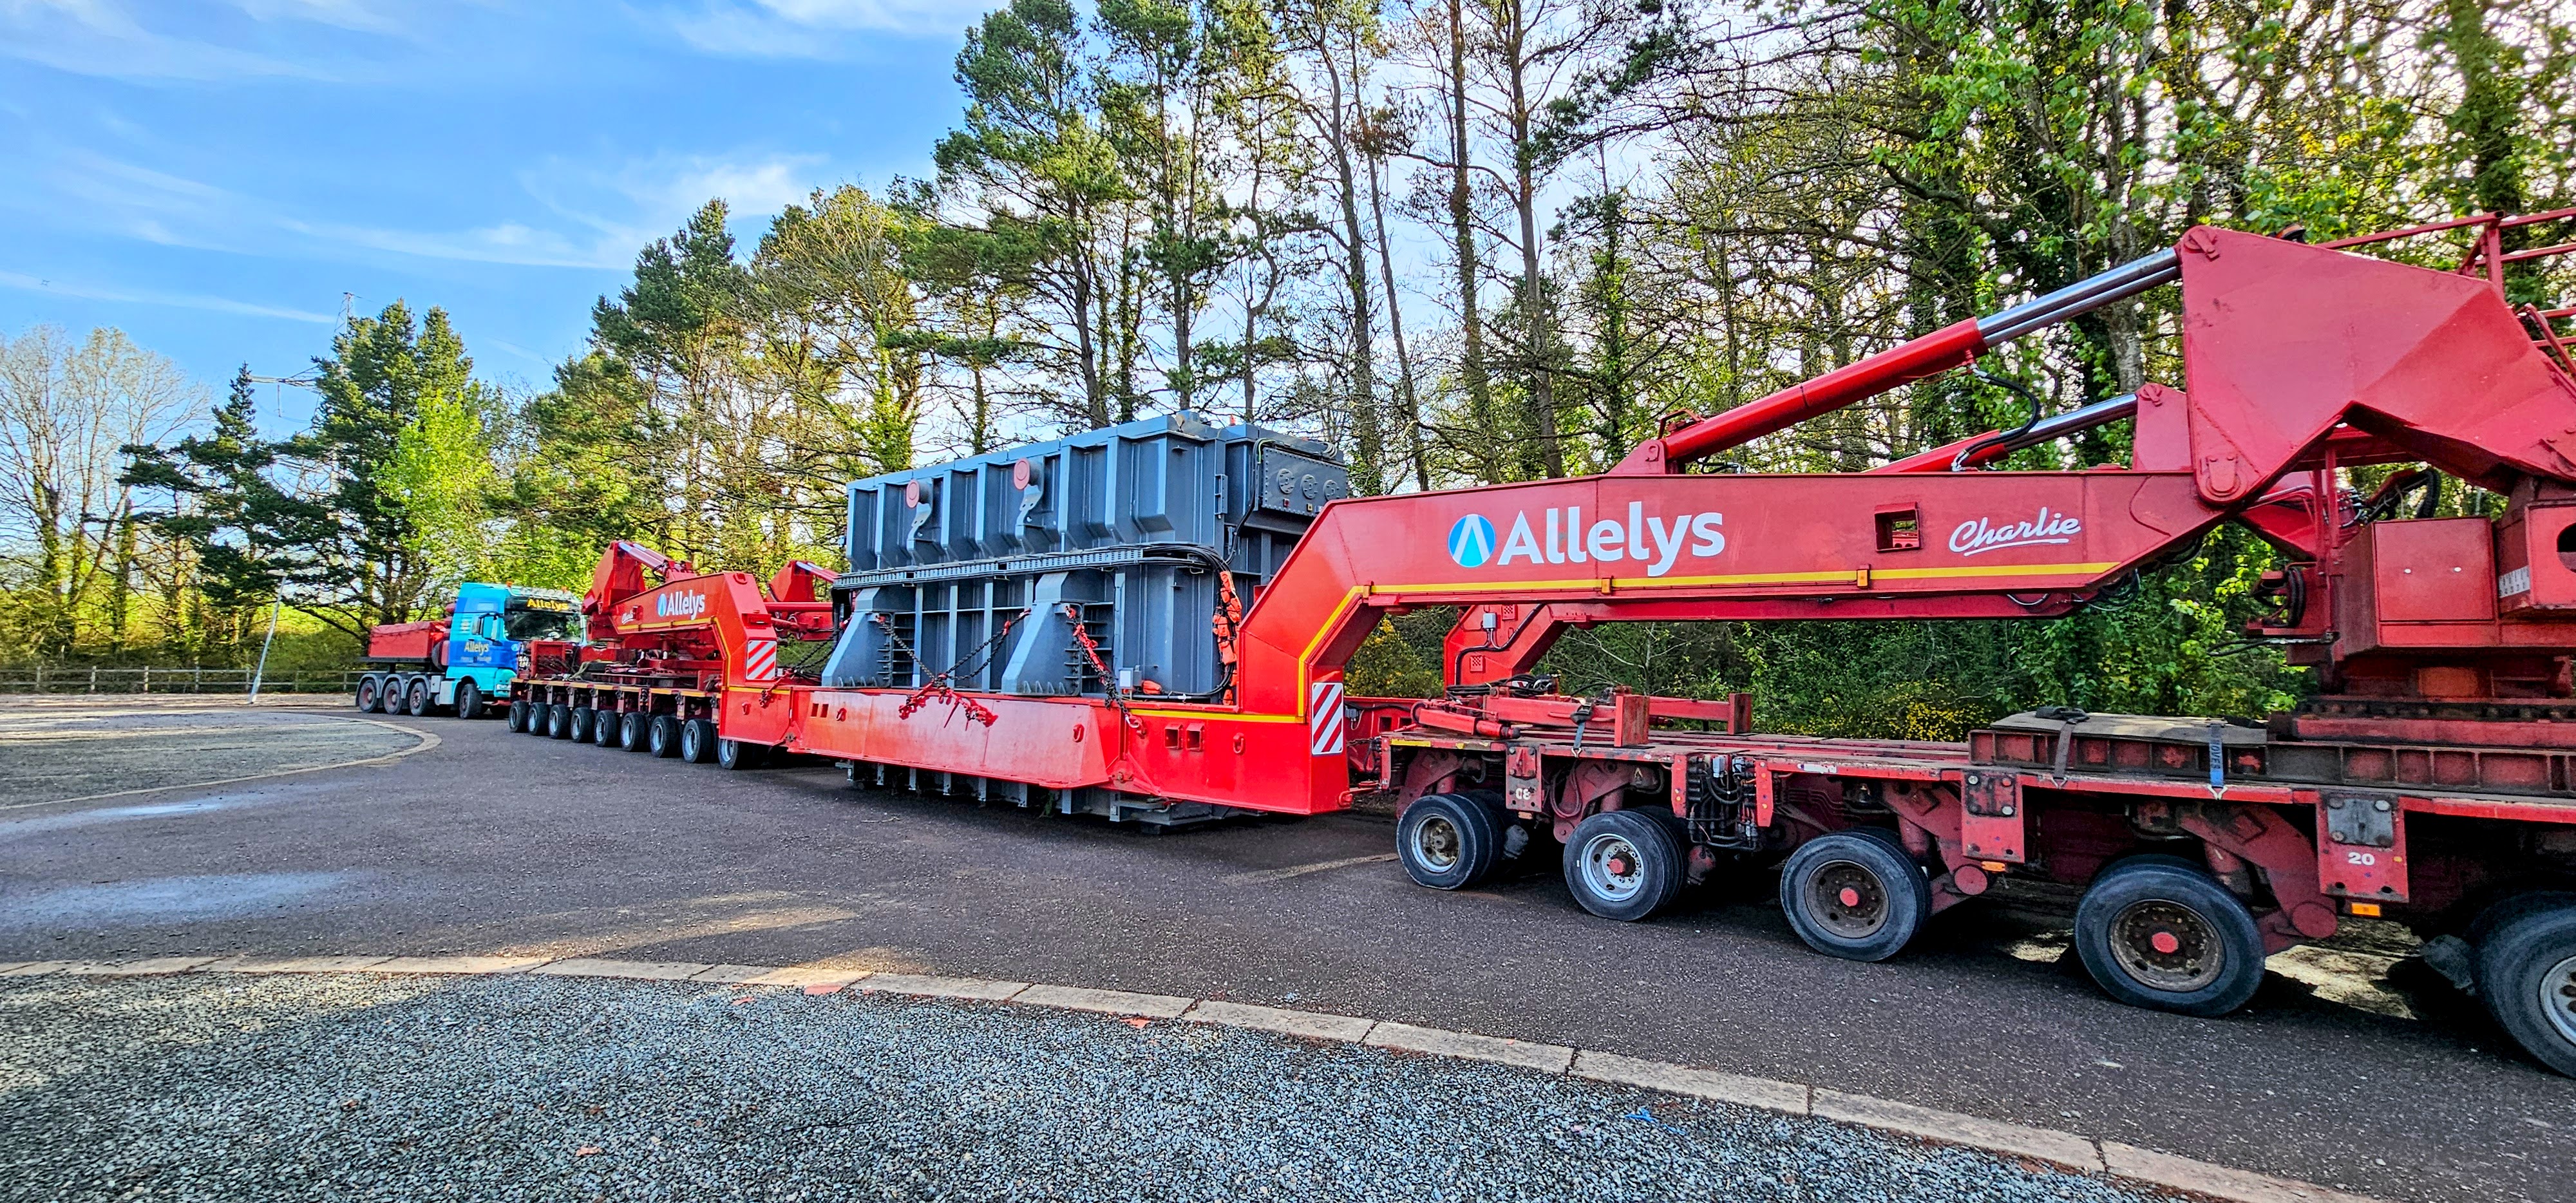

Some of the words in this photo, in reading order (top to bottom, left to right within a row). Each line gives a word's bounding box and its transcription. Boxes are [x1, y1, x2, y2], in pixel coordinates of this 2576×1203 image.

[1497, 501, 1726, 577] Allelys
[1949, 506, 2082, 554] Charlie
[527, 598, 569, 612] Allelys
[665, 589, 705, 620] Allelys
[464, 641, 489, 656] Allelys
[2347, 851, 2375, 866] 20
